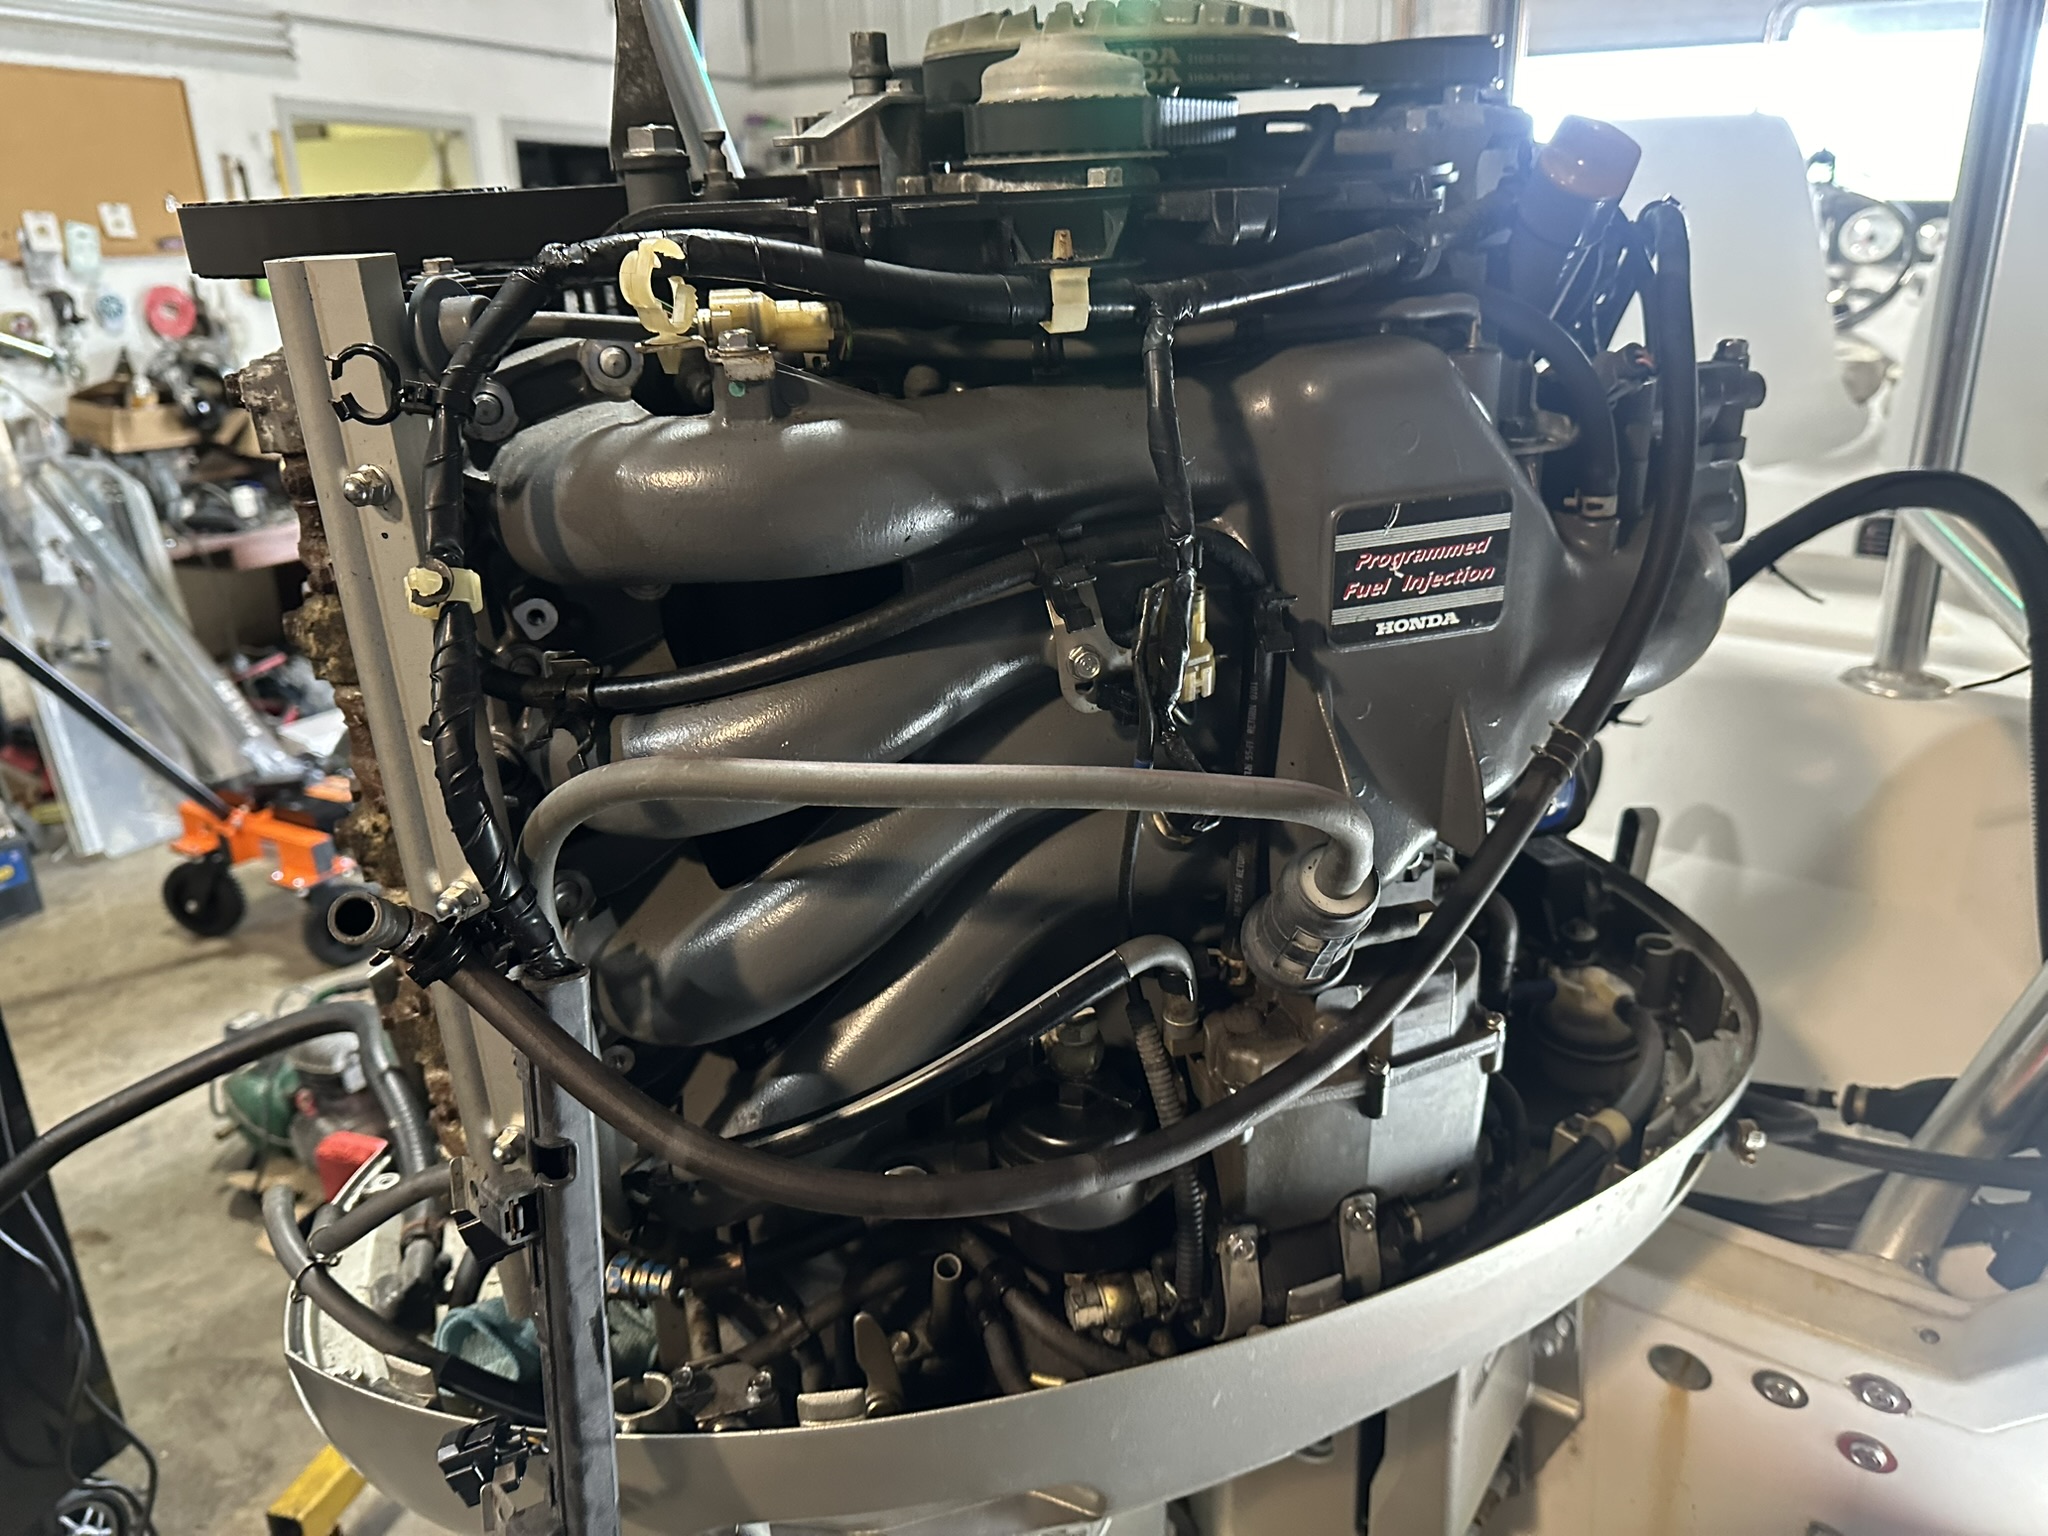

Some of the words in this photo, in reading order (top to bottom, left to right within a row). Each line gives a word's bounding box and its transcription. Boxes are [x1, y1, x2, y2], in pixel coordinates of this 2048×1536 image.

[1354, 536, 1493, 573] Programmed
[1342, 577, 1392, 601] Fuel
[1401, 565, 1496, 595] Injection
[1375, 611, 1461, 636] HONDA
